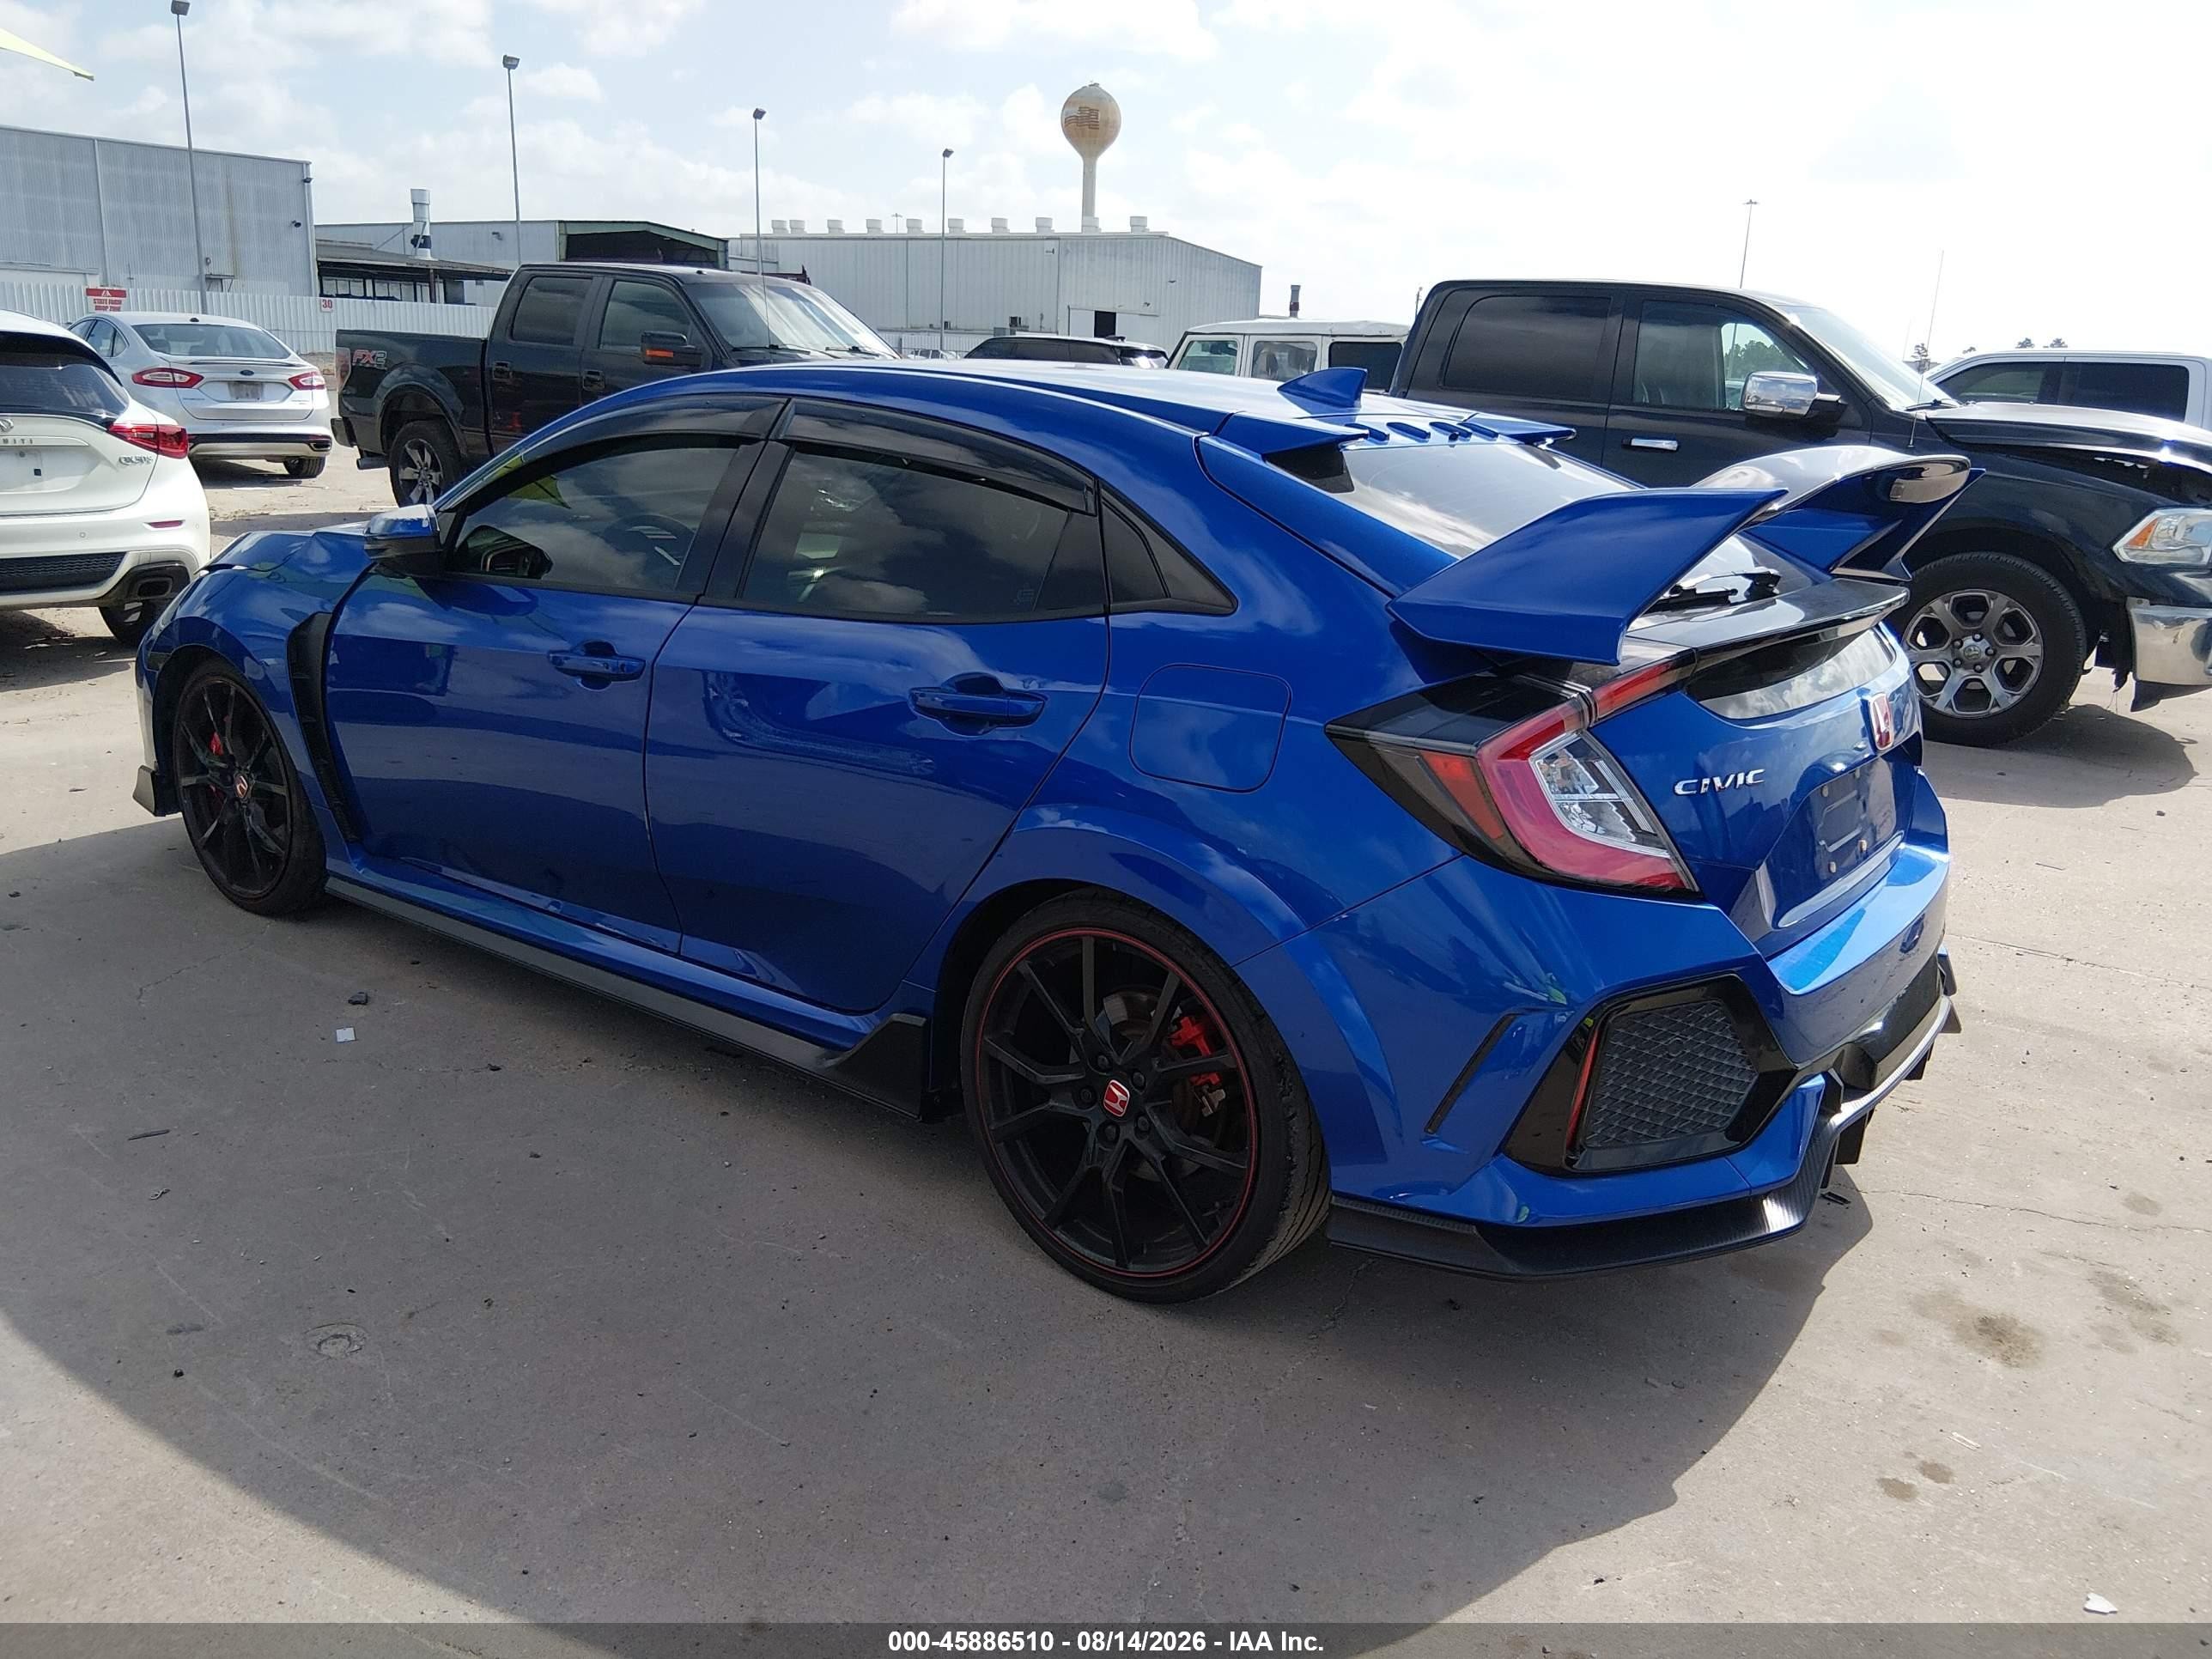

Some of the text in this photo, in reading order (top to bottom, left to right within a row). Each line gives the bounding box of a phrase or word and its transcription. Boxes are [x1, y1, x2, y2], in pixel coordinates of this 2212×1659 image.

[322, 299, 333, 308] 30
[352, 349, 387, 366] FX2
[1674, 769, 1765, 796] CIVIC
